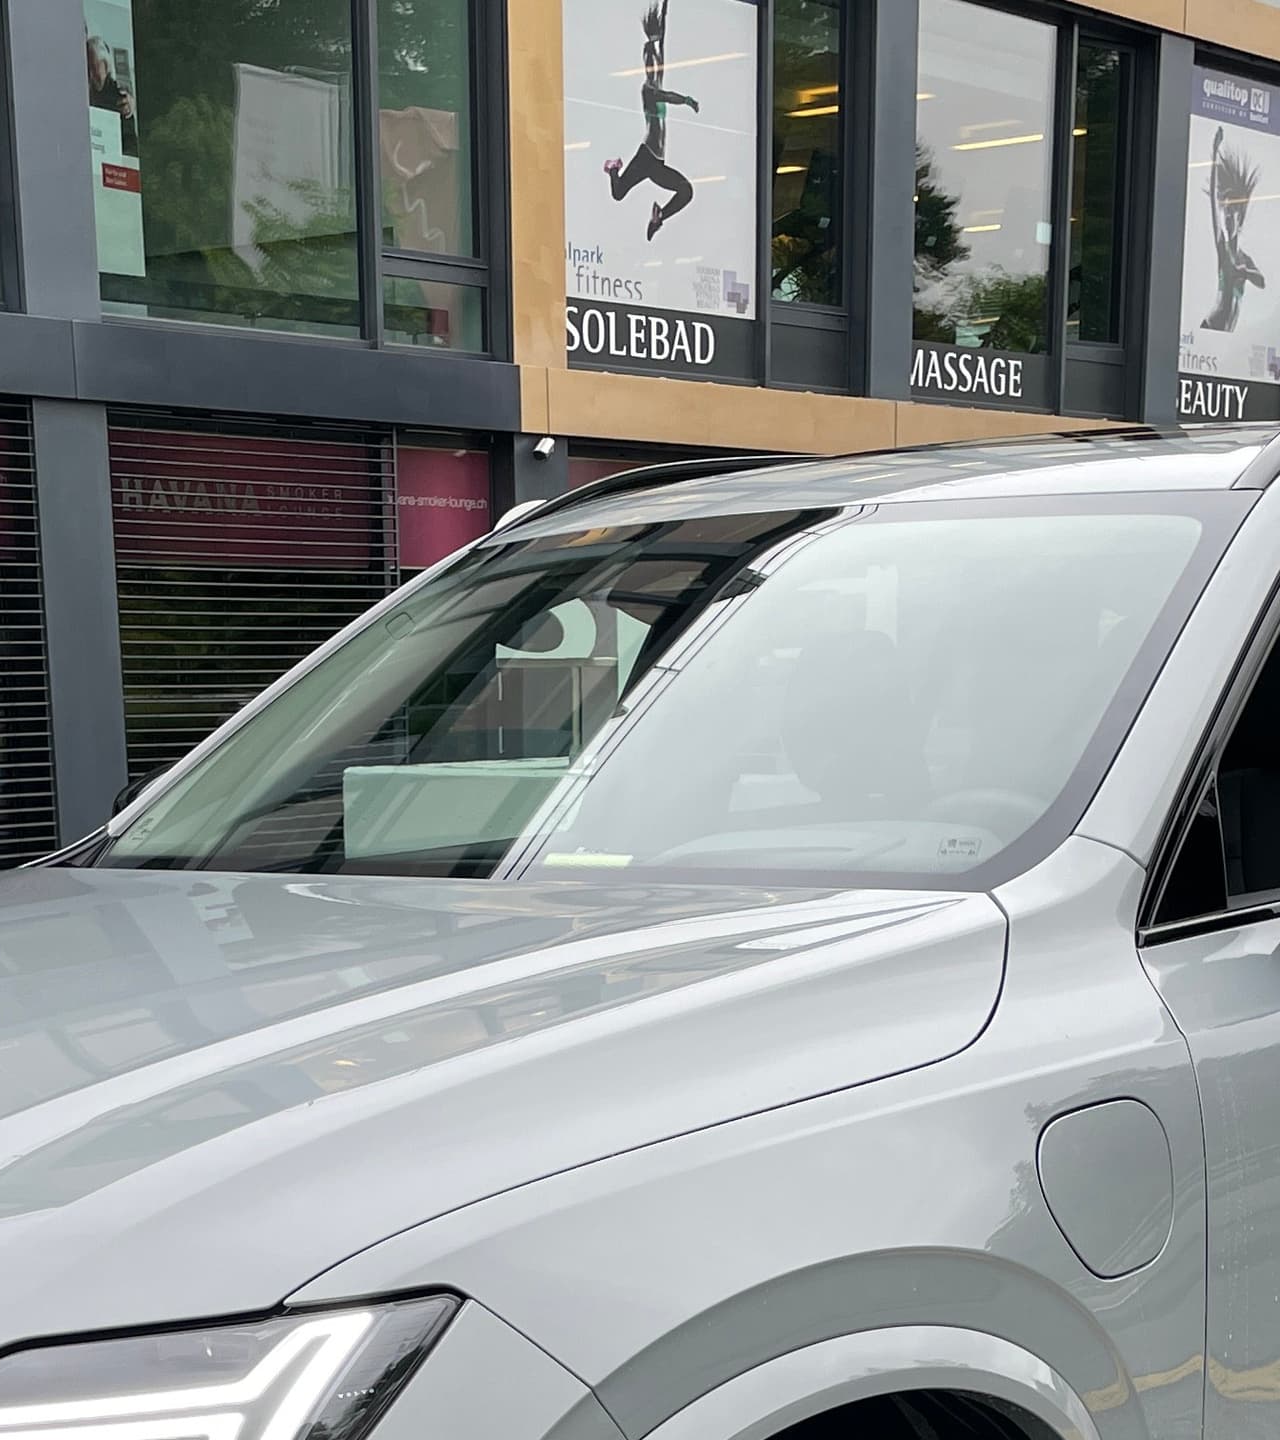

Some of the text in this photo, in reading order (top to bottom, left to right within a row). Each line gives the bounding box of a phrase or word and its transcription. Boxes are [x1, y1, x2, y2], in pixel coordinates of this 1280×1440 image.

[1203, 79, 1248, 106] qualitop
[576, 265, 643, 300] fitness
[566, 306, 715, 365] SOLEBAD
[1176, 379, 1248, 419] EAUTY
[267, 487, 343, 501] SMOKER
